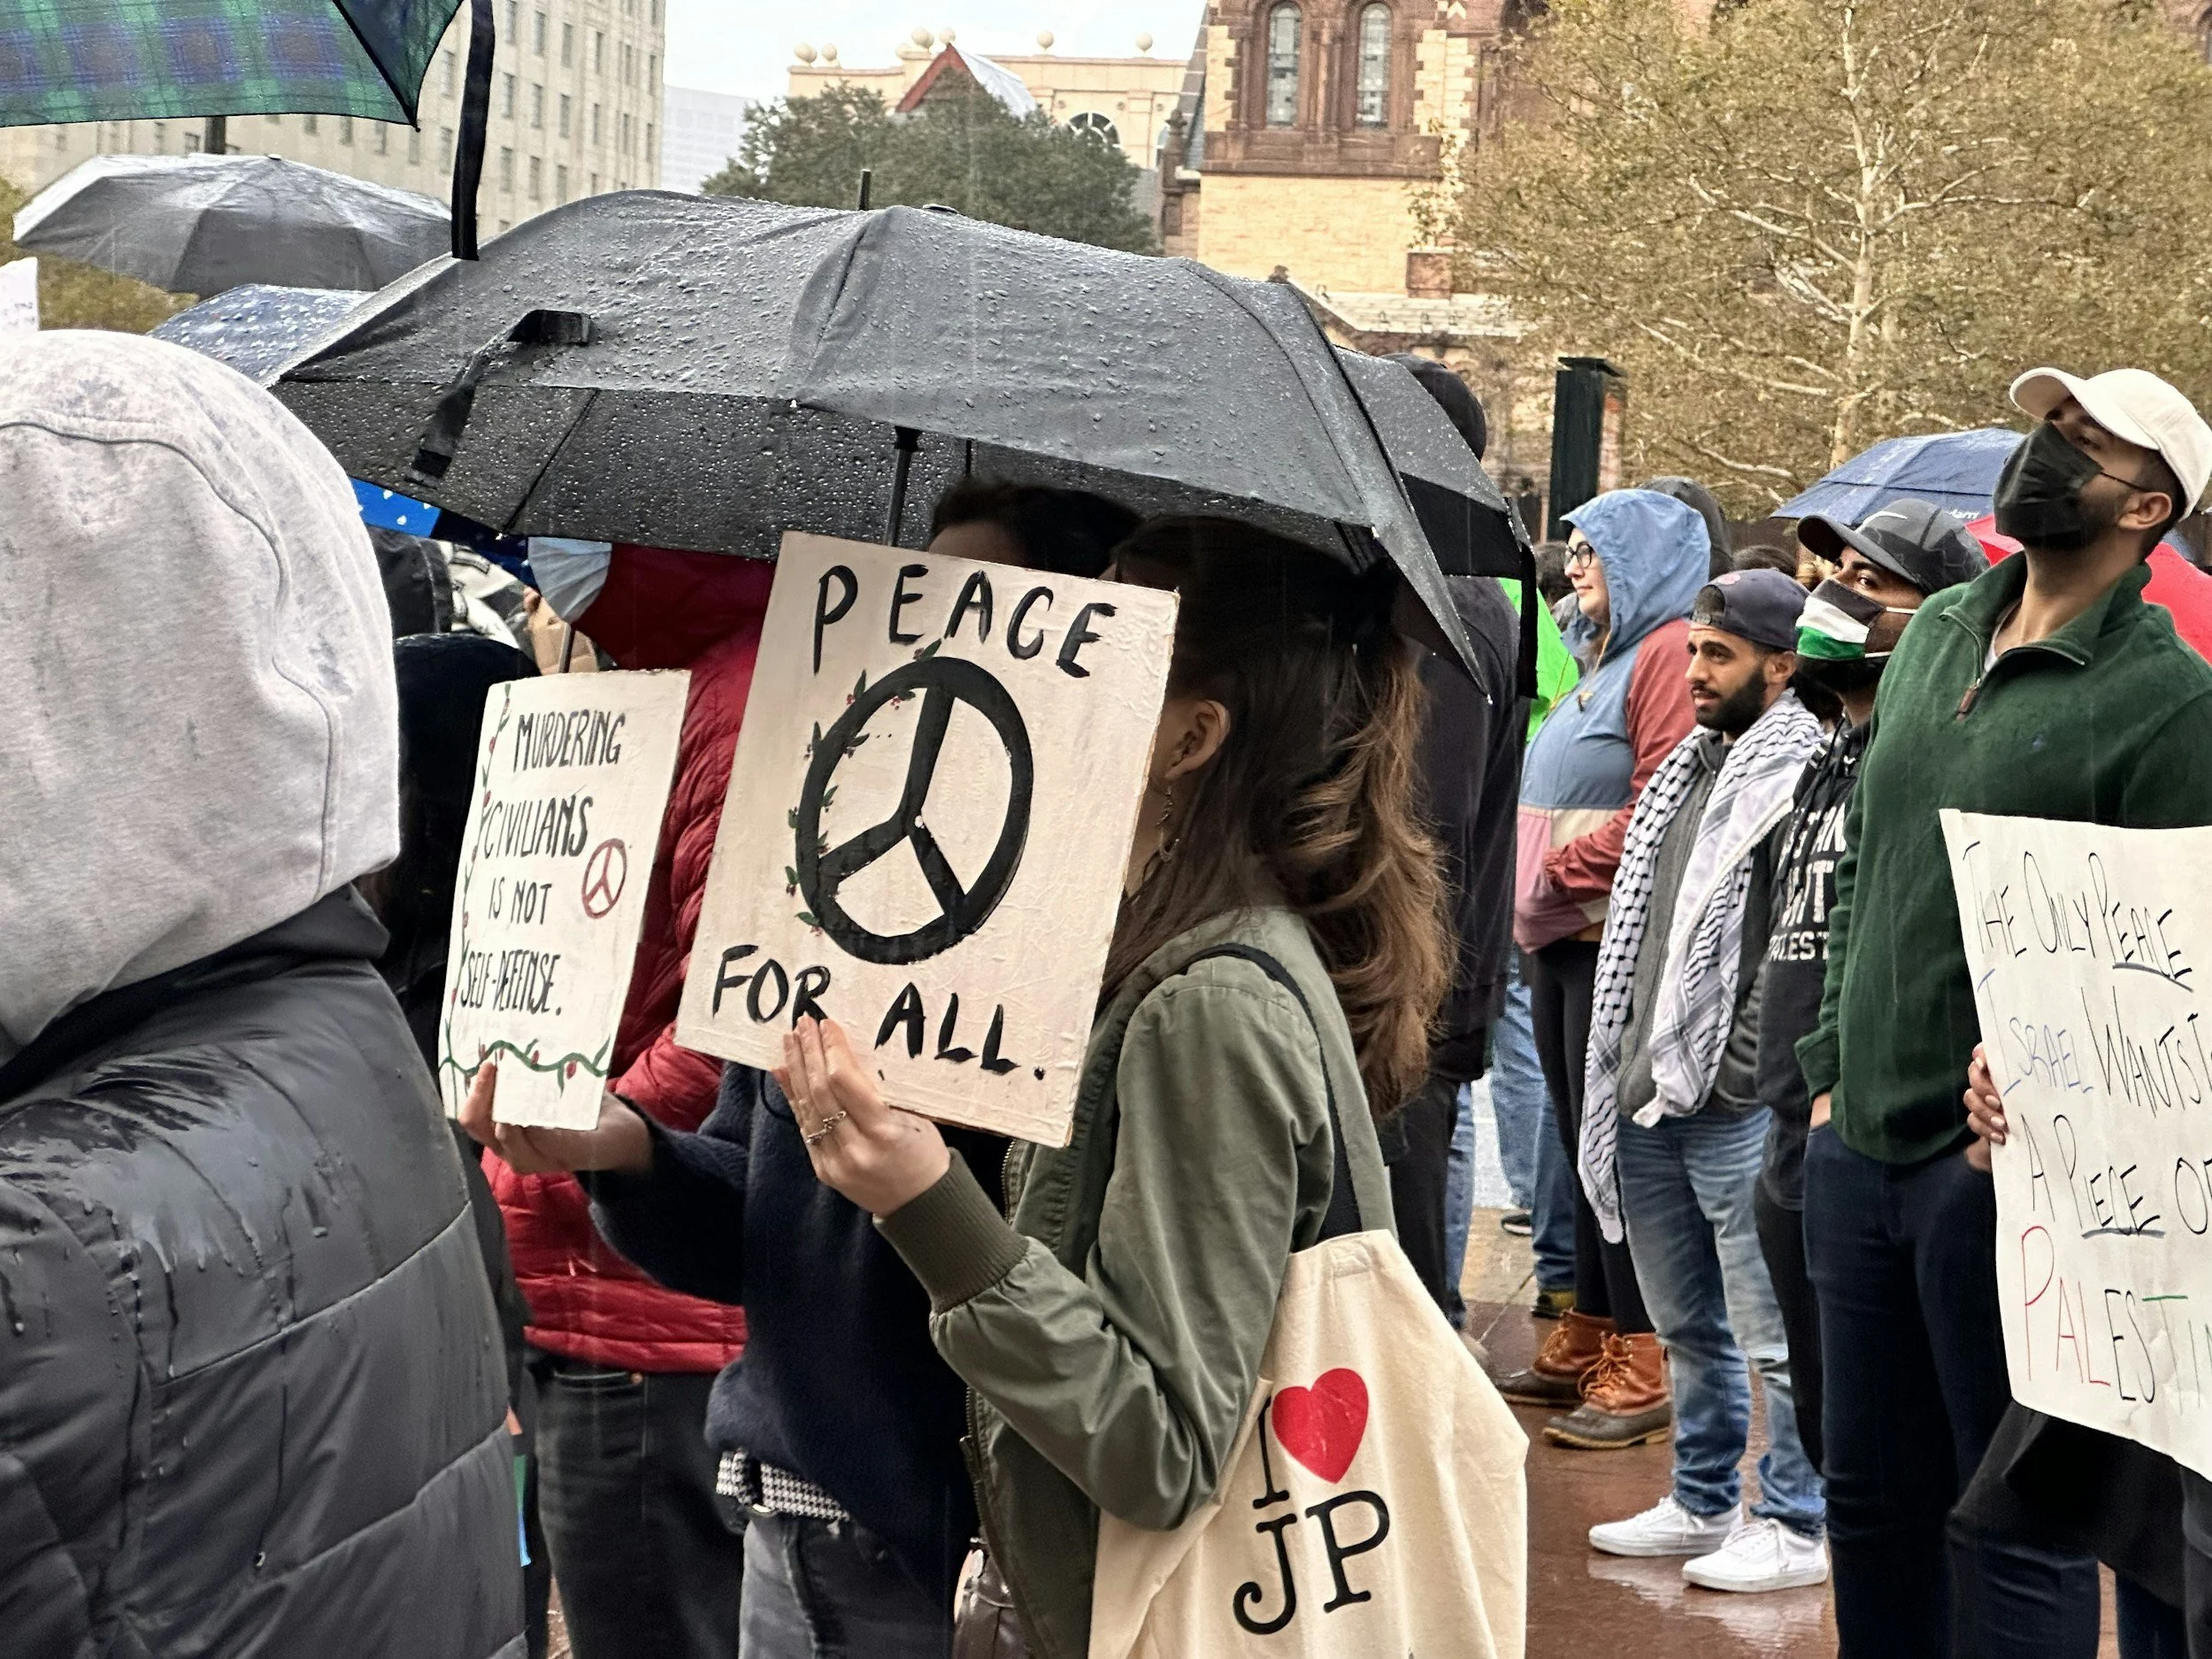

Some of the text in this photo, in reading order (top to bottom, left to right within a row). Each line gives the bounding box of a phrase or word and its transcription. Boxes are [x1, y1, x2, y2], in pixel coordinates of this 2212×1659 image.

[812, 563, 1118, 678] PEACE
[513, 710, 626, 772] MURDERING
[485, 794, 594, 859] CIVILIANS
[488, 876, 553, 926] IS NOT
[1962, 841, 2193, 979] THE ONLY PEACE
[460, 949, 562, 1017] SELF-DEFENSE.
[712, 944, 1046, 1081] FOR ALL.
[1977, 968, 2094, 1097] ISRAEL
[2080, 986, 2201, 1118] WANTS
[2021, 1114, 2055, 1223] A
[2053, 1114, 2161, 1235] PIECE
[2021, 1225, 2212, 1416] PALESTI
[1253, 1395, 1289, 1509] I
[1233, 1489, 1390, 1635] JP
